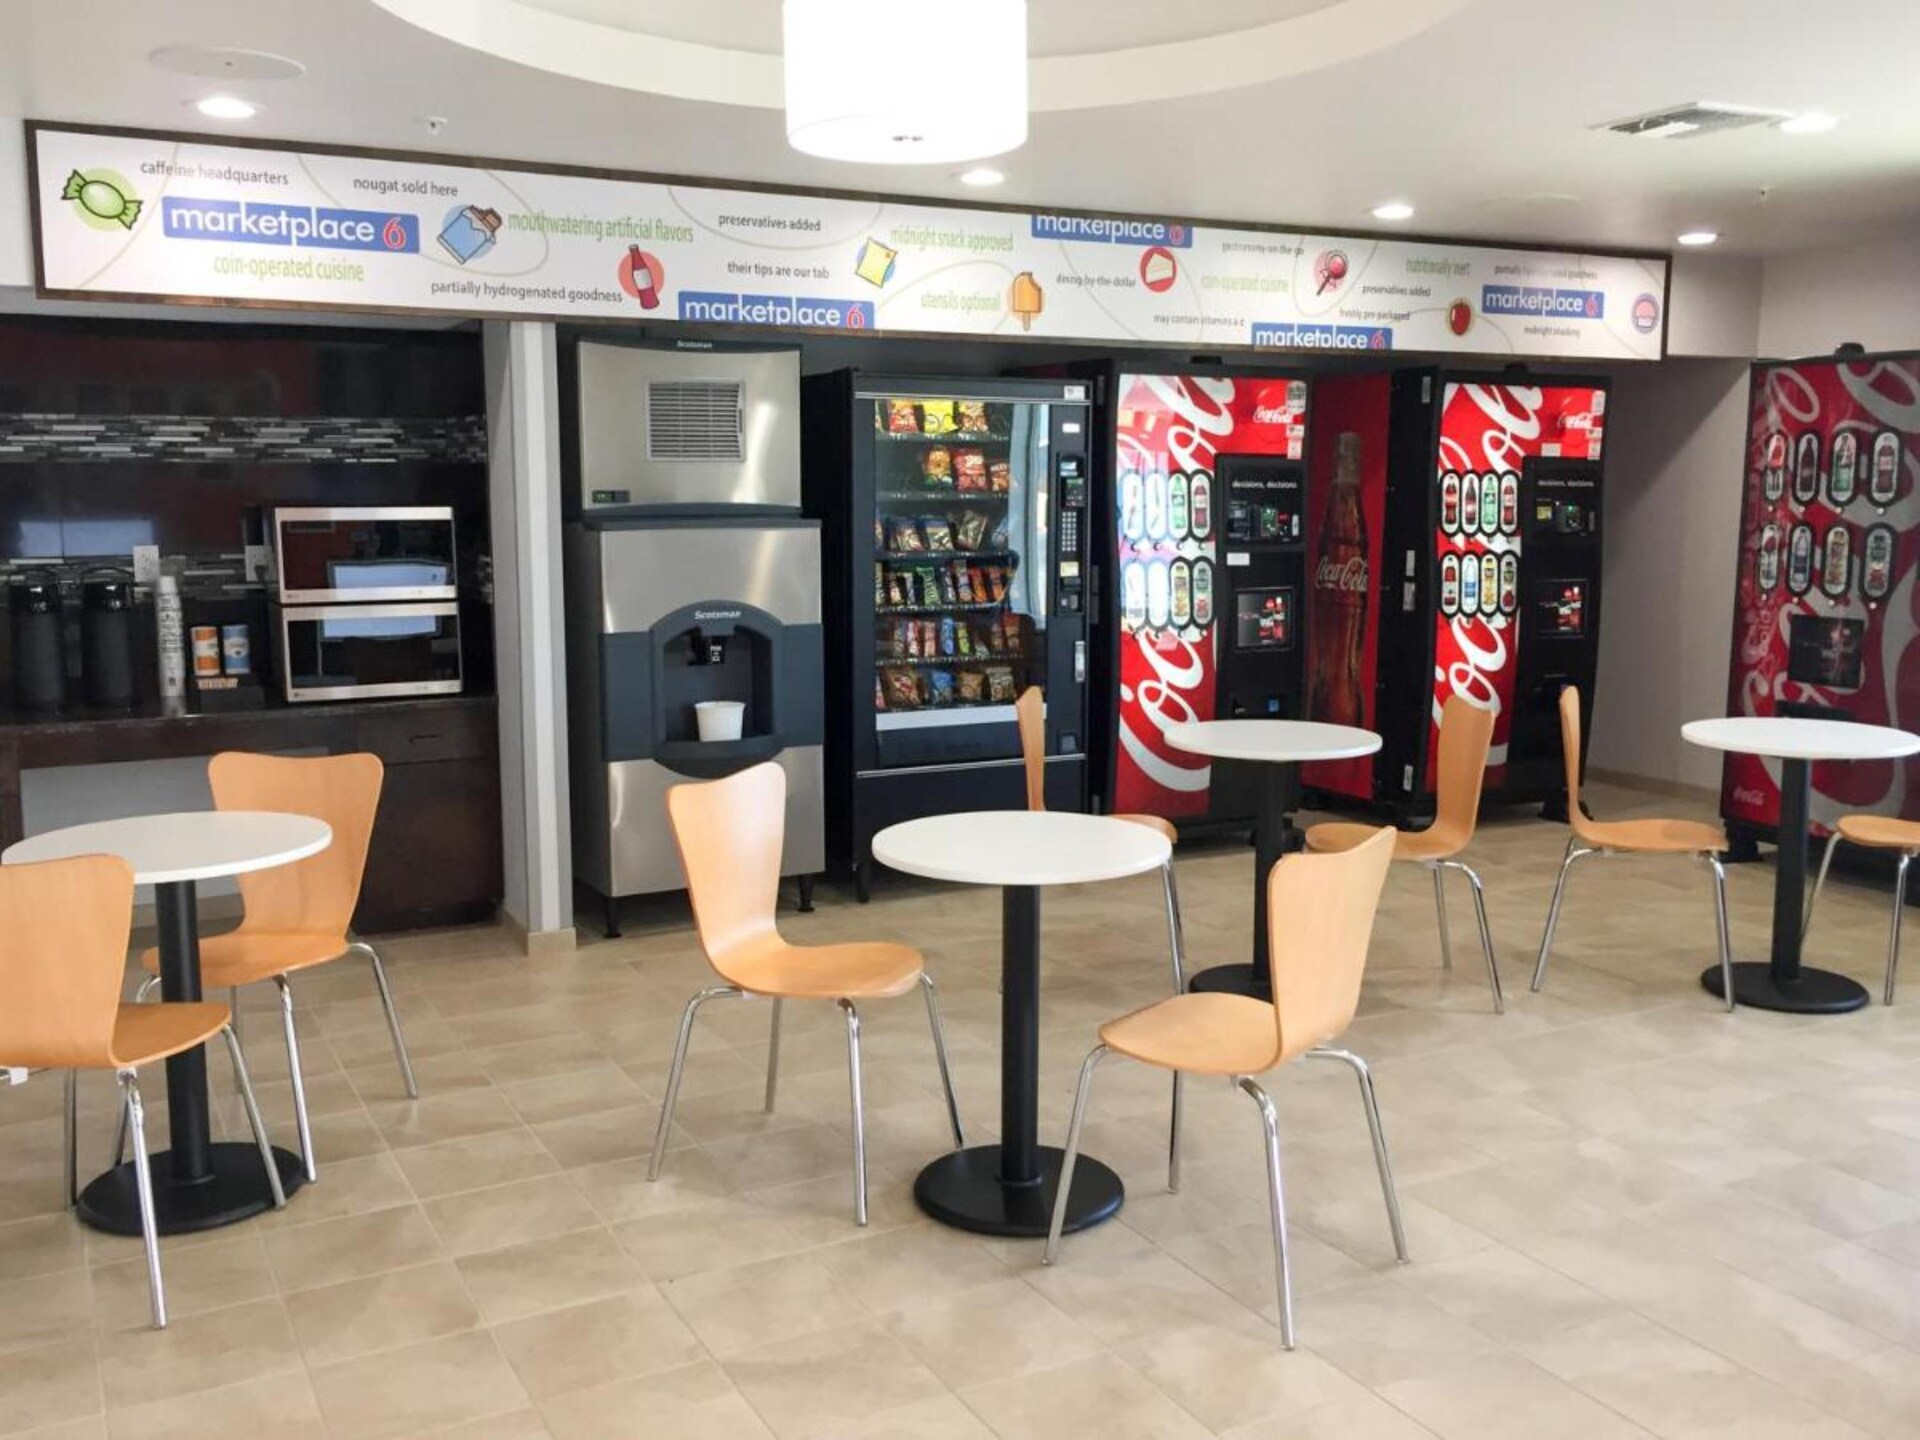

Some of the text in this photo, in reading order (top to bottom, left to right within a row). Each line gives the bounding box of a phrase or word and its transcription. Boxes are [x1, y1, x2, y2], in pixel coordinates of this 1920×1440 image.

[140, 161, 290, 186] caffeine headquarters
[353, 176, 458, 197] nougat sold here
[170, 200, 408, 251] marketplace 6
[508, 211, 693, 242] mouthwatering artificial flavors
[718, 212, 821, 232] preservatives added
[1036, 215, 1165, 244] marketplace
[213, 253, 365, 283] coin-operated cuisine
[727, 261, 830, 280] their tips are our tab
[430, 280, 623, 304] partially hydrogenated goodness
[1485, 287, 1584, 317] marketplace
[684, 293, 841, 327] marketplace
[1255, 323, 1369, 349] marketplace
